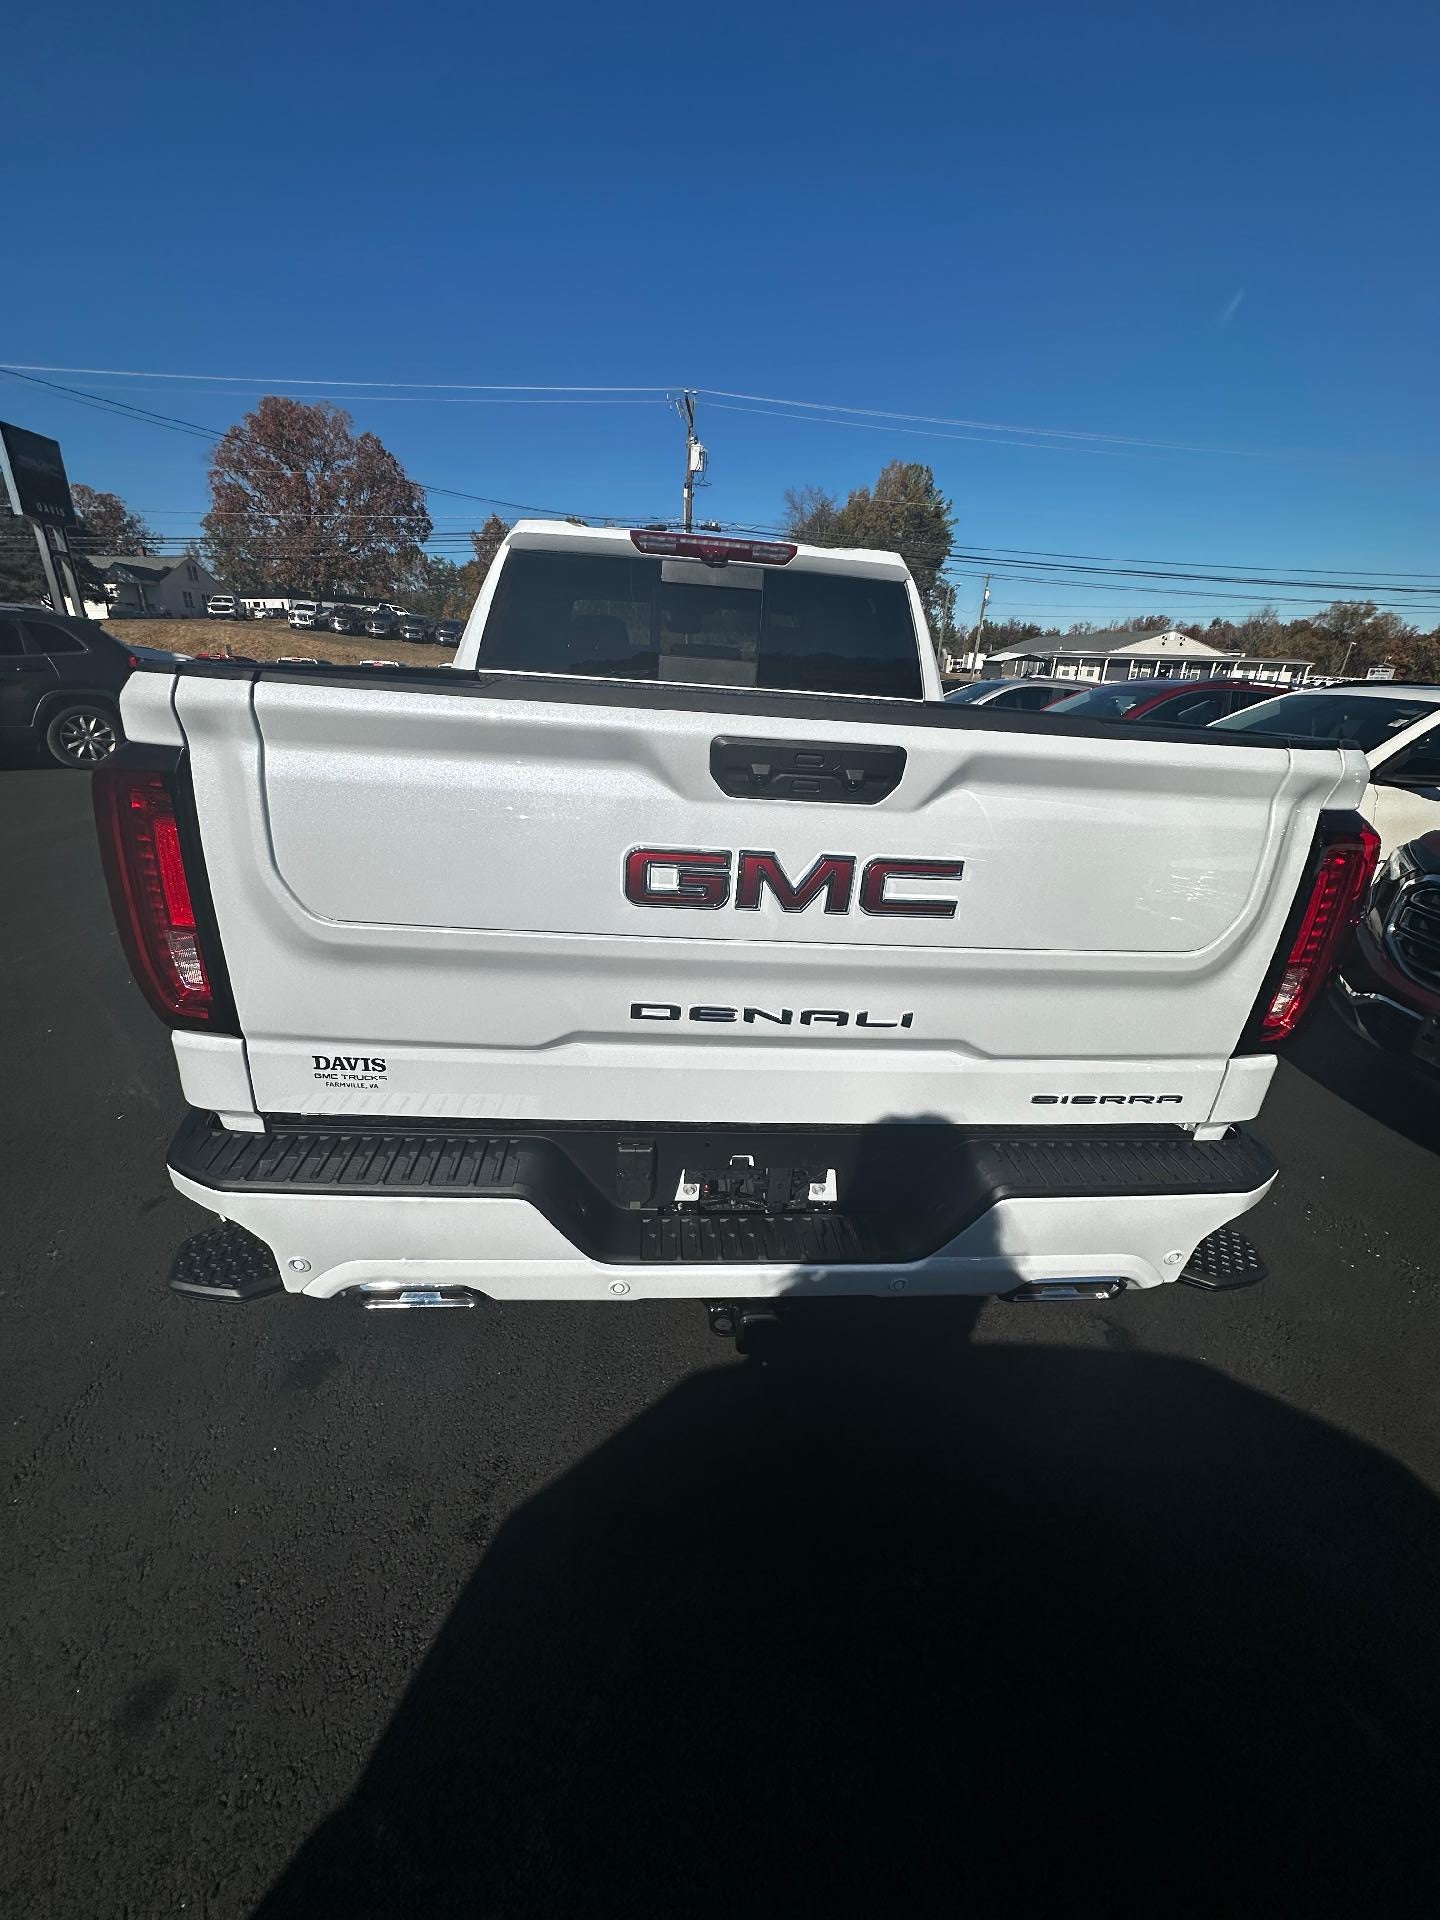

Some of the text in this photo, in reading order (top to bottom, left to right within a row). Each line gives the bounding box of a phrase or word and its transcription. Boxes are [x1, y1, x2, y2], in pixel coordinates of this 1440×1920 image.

[624, 845, 965, 919] GMC
[630, 1002, 914, 1029] DENALI
[311, 1055, 387, 1073] DAVIS
[314, 1072, 339, 1080] GMC
[325, 1081, 368, 1090] FARMVILLE,
[1030, 1094, 1184, 1105] SIERRA
